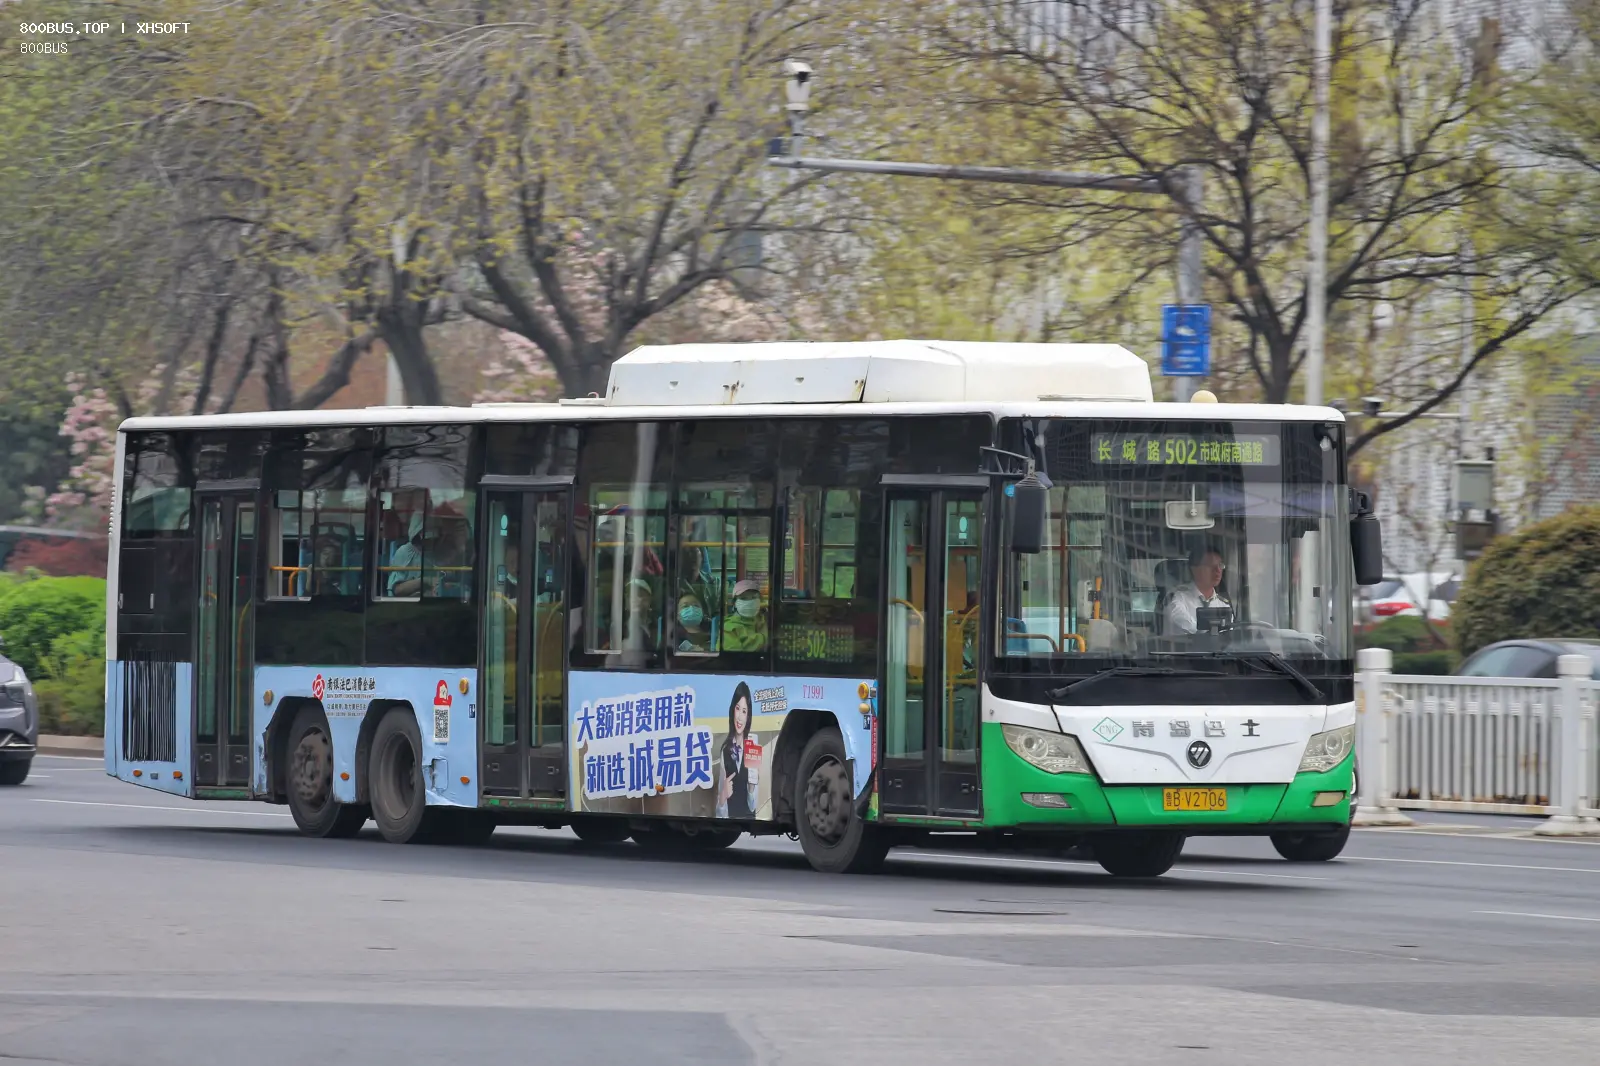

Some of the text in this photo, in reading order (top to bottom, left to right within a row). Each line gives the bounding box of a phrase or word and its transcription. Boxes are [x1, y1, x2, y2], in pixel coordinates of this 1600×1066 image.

[1165, 438, 1198, 464] 502
[806, 630, 826, 658] 502
[577, 692, 693, 742] 大额消费用款
[1099, 724, 1118, 735] CNG
[586, 732, 711, 793] 就选诚易贷
